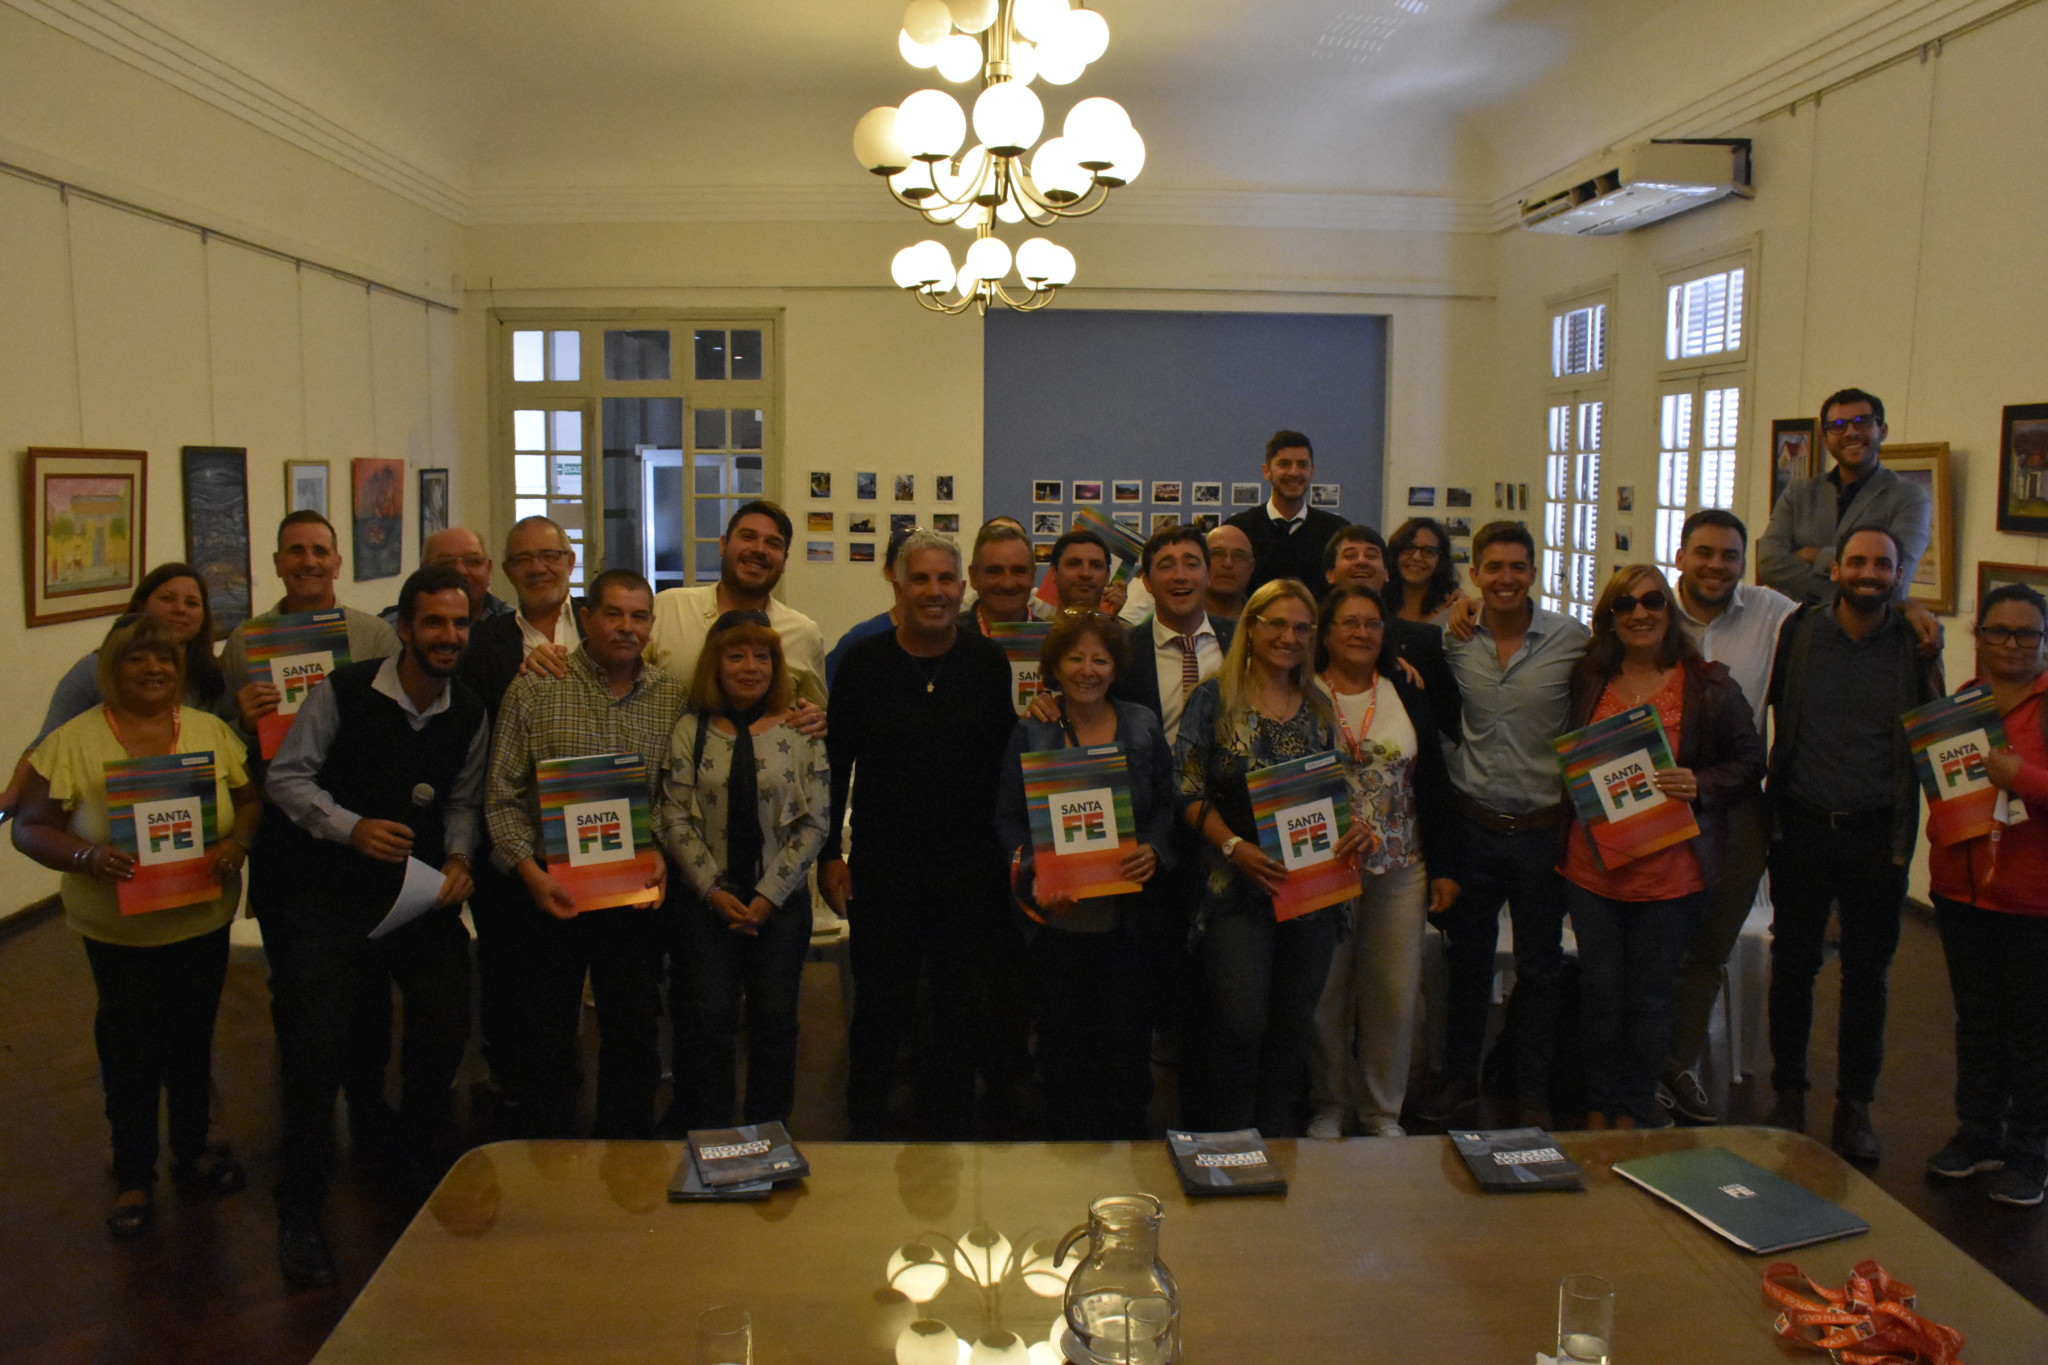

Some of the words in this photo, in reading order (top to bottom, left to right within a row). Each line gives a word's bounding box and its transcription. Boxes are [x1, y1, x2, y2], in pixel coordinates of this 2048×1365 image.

[282, 663, 324, 677] SANTA
[1018, 672, 1040, 681] SAN
[1939, 743, 1979, 763] SANTA
[1604, 763, 1643, 785] SANTA
[1942, 753, 1988, 788] FE
[1607, 772, 1653, 810] FE
[148, 810, 191, 824] SANTA
[577, 811, 619, 825] SANTA
[1061, 800, 1103, 815] SANTA
[1062, 811, 1107, 843] FE
[1287, 812, 1326, 831] SANTA
[148, 821, 194, 853] FE
[578, 822, 623, 854] FE
[1289, 822, 1331, 858] FE
